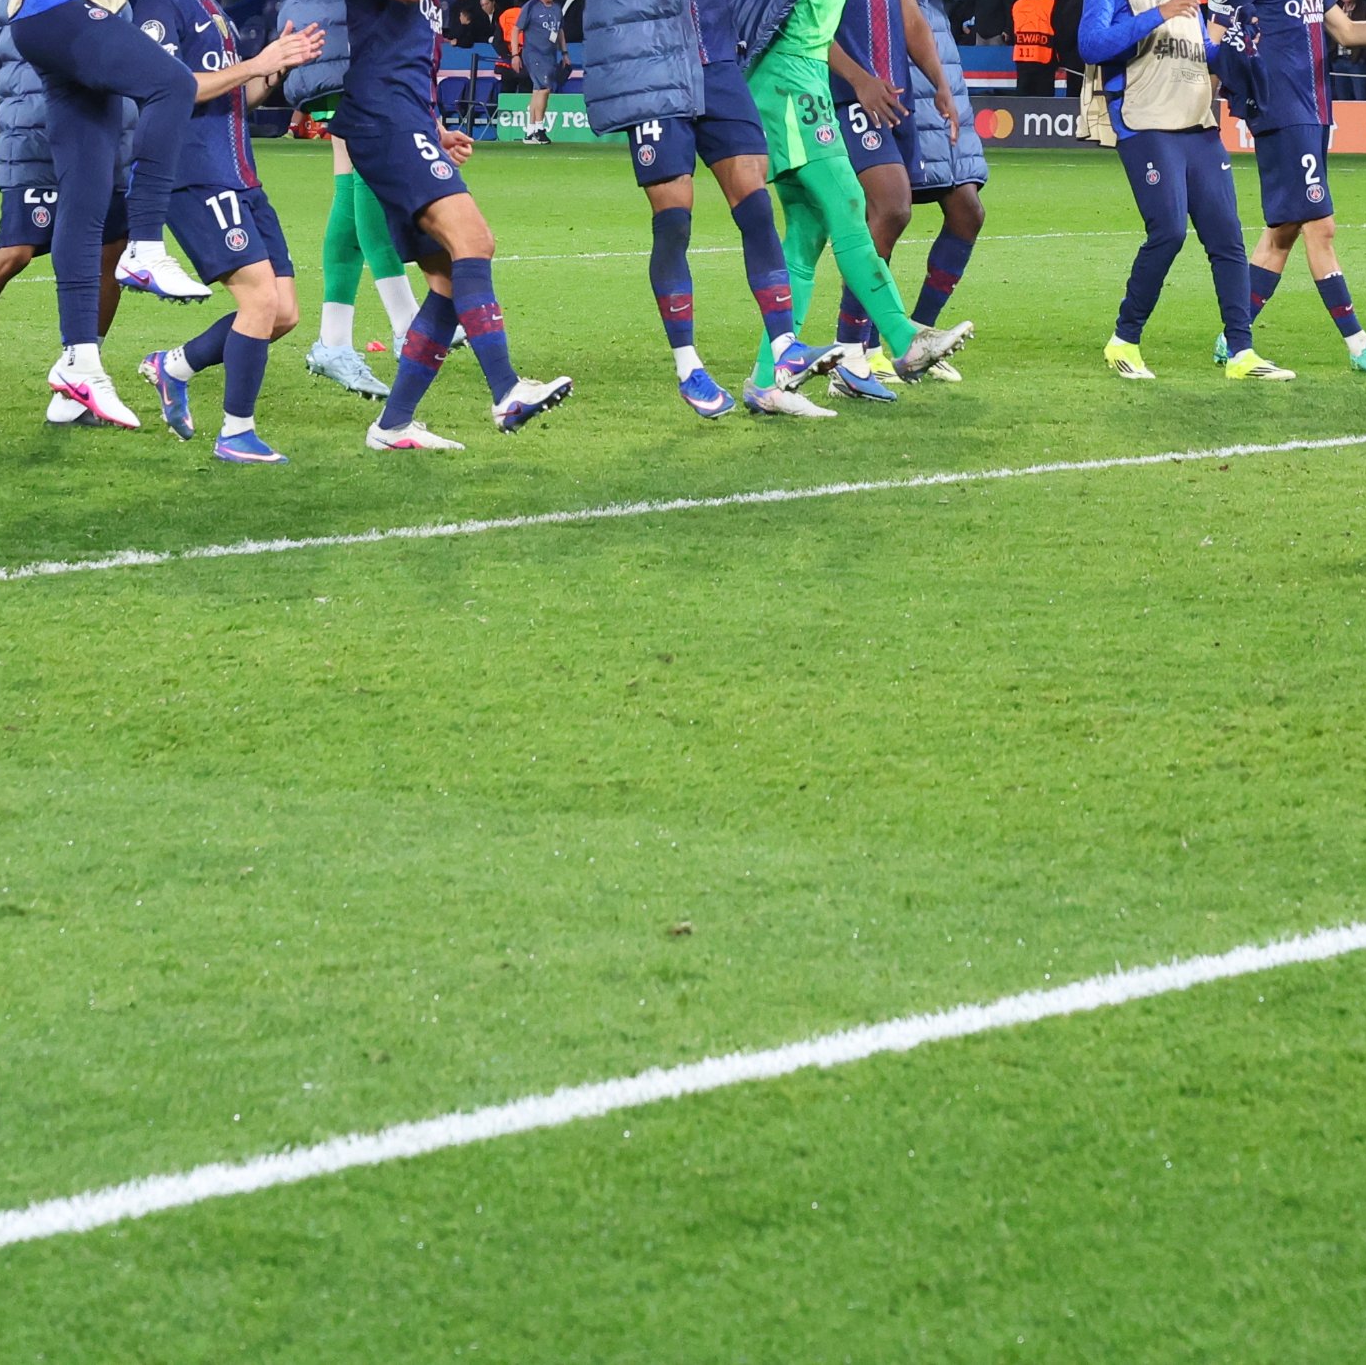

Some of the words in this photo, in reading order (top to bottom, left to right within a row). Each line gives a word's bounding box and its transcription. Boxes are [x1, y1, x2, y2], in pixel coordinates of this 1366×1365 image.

[413, 132, 440, 160] 5
[635, 119, 663, 144] 14
[1301, 153, 1320, 185] 2
[205, 190, 242, 230] 17
